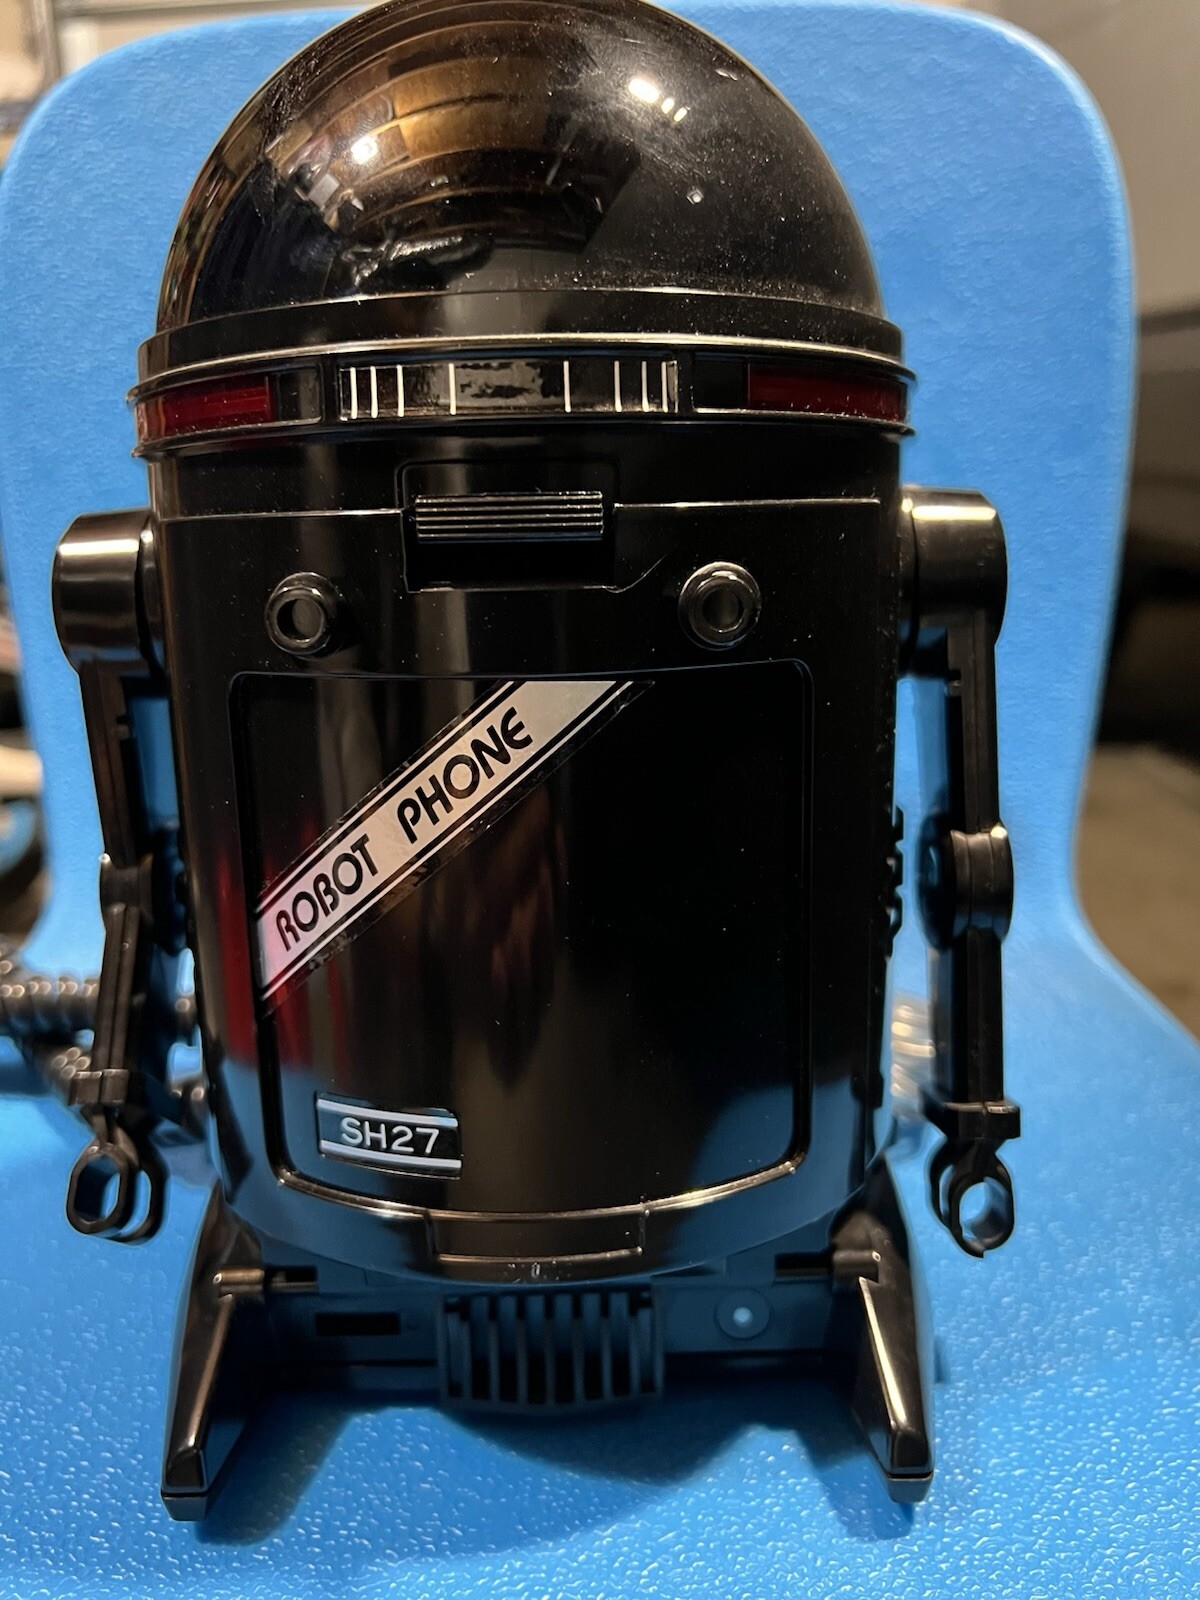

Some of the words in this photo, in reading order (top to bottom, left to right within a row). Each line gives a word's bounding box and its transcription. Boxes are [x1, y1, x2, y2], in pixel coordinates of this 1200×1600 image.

[275, 833, 379, 952] ROBOT
[396, 706, 534, 845] PHONE
[340, 1116, 440, 1154] SH27
